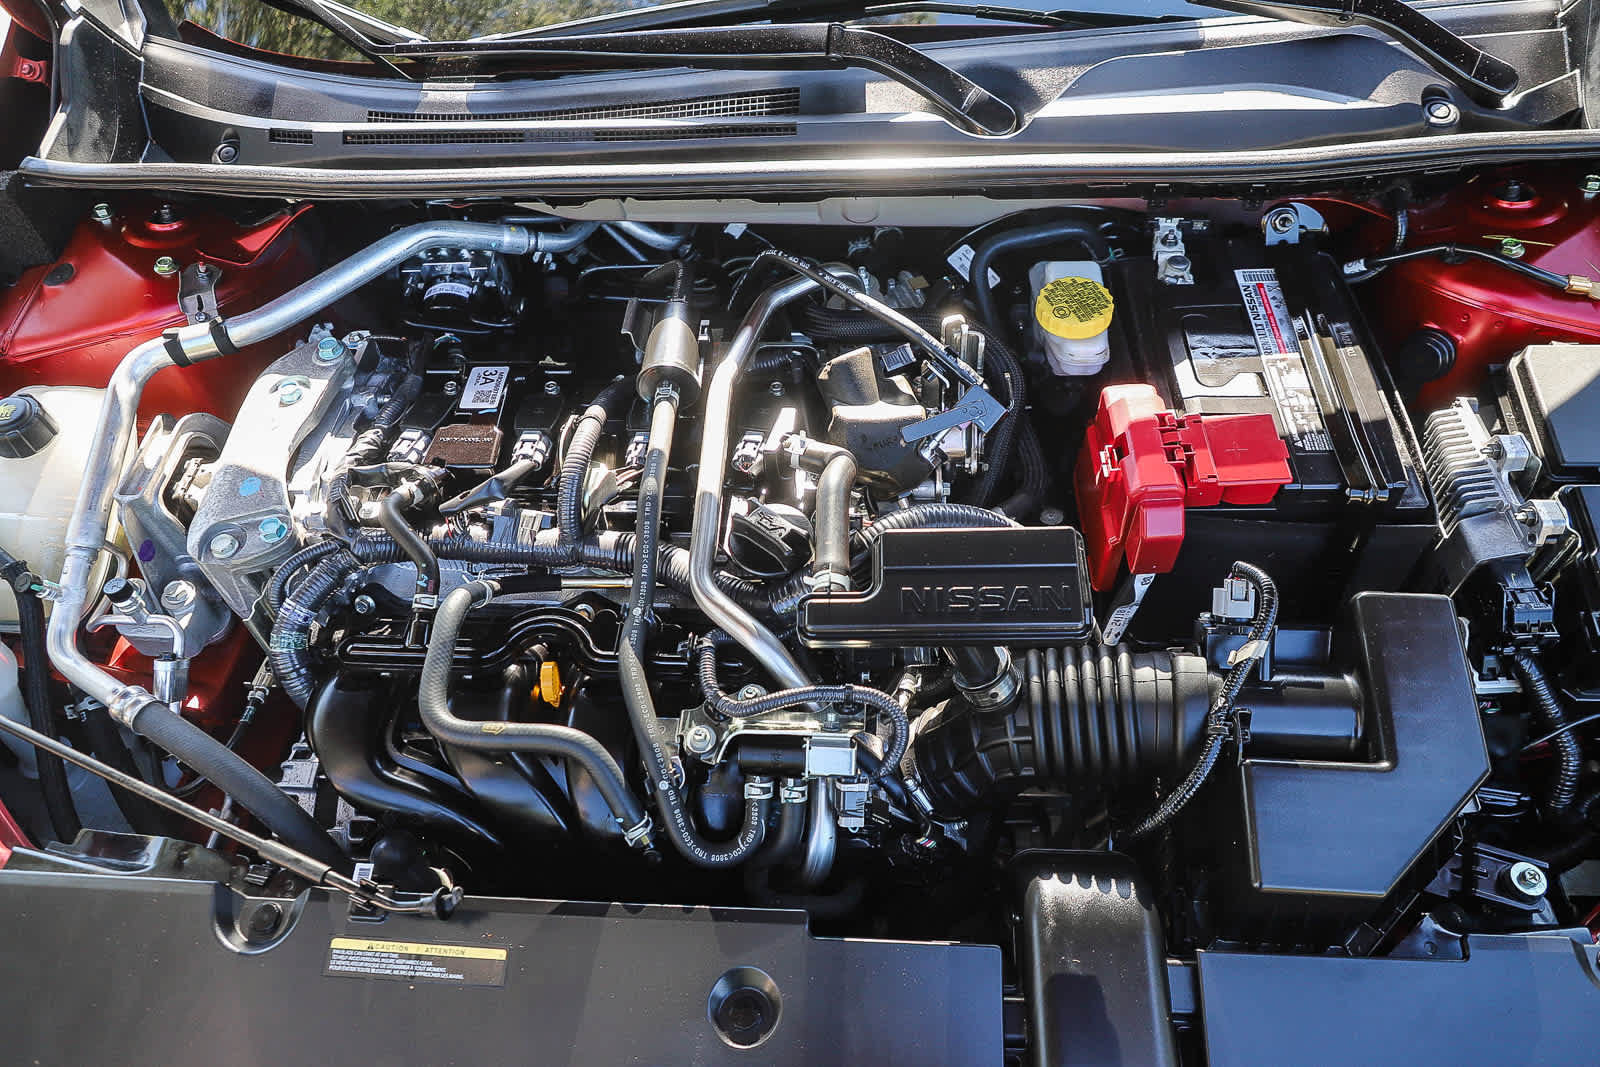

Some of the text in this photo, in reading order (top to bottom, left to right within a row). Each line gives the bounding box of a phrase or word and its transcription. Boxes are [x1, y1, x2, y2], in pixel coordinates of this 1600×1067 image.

[1241, 284, 1262, 321] NISSAN
[1255, 322, 1273, 356] RENAULT
[479, 369, 498, 386] 3A
[900, 585, 1072, 612] NISSAN
[375, 942, 409, 952] CAUTION
[424, 946, 465, 956] ATTENTION
